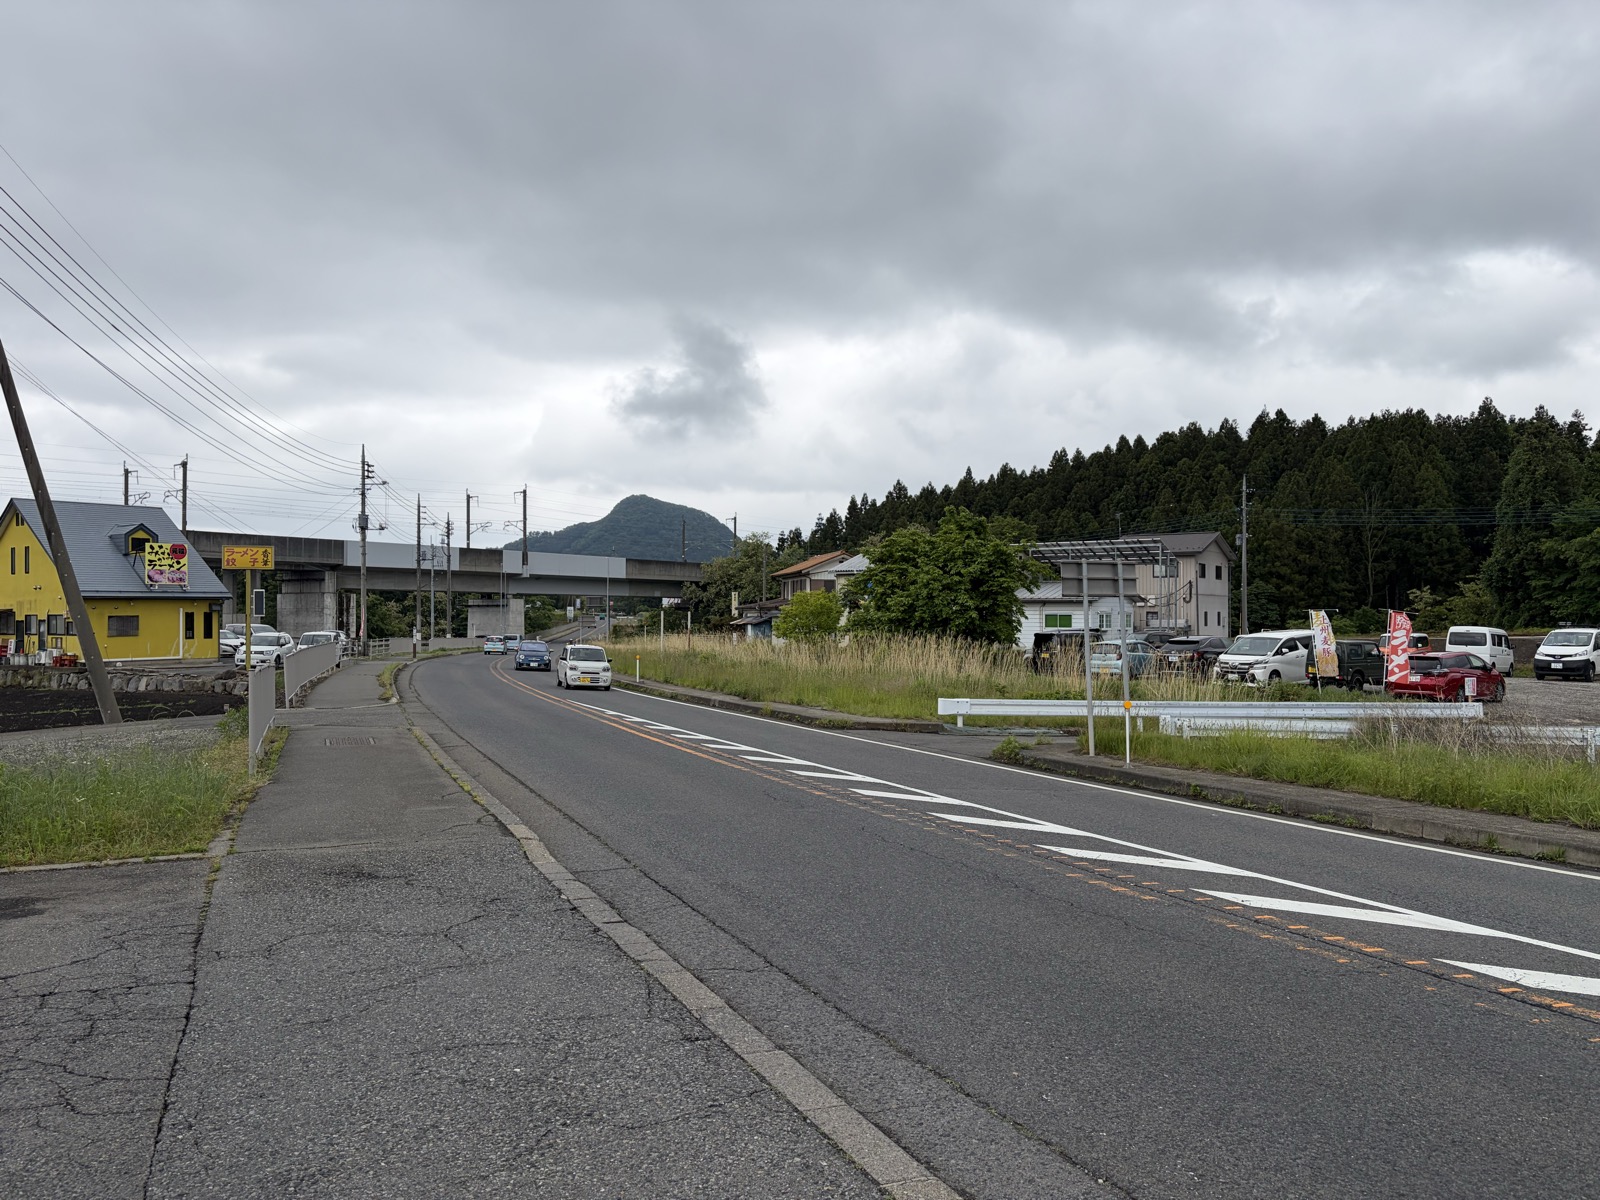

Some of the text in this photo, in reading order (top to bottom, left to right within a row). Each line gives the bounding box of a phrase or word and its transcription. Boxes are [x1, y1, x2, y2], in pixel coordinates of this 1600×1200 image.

[225, 548, 259, 557] ラーメン
[147, 558, 187, 571] ラーメン
[225, 558, 259, 566] 餃子
[1320, 616, 1332, 657] 上州麦豚
[1388, 630, 1410, 682] ラーメン
